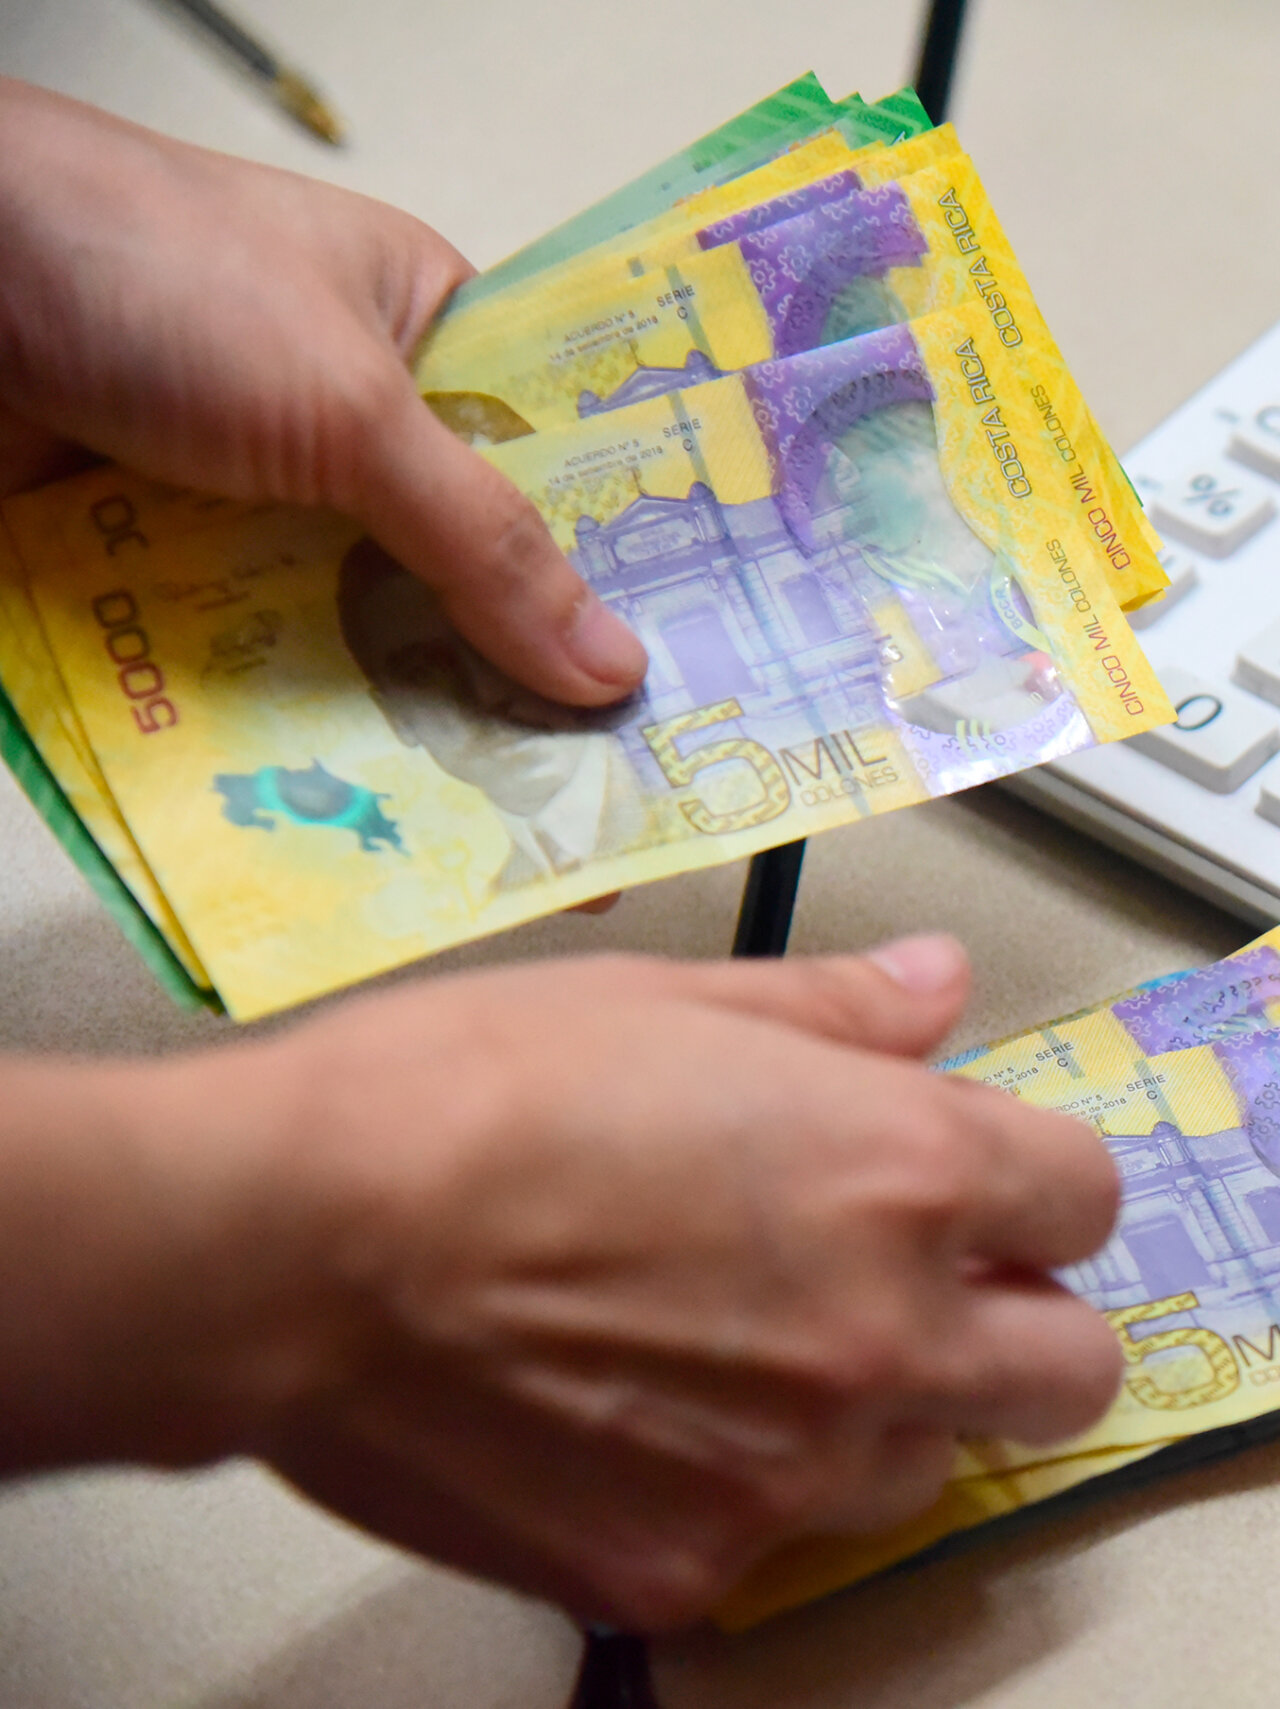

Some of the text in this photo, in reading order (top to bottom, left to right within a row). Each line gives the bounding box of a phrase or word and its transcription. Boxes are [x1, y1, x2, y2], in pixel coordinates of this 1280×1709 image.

[937, 187, 1024, 349] COSTA RICA
[657, 285, 695, 308] SERIE
[677, 306, 688, 320] C
[662, 418, 702, 438] SERIE
[955, 337, 1033, 499] COSTA RICA
[640, 445, 663, 459] 2018
[682, 438, 694, 451] C
[564, 445, 617, 468] ACUERDO
[1030, 384, 1131, 571] CINCO MIL COLONES
[1046, 538, 1144, 716] CINCO MIL COLONES
[92, 587, 181, 735] 5000
[1173, 694, 1223, 732] 0
[640, 696, 888, 835] 5 MIL
[801, 765, 899, 807] COLONES
[1035, 1041, 1074, 1062] SERIE
[1007, 1066, 1015, 1074] 5
[1057, 1057, 1069, 1068] C
[1002, 1078, 1014, 1087] de
[1015, 1067, 1039, 1082] 2018
[1126, 1074, 1167, 1093] SERIE
[1088, 1105, 1101, 1114] de
[1103, 1097, 1127, 1110] 2018
[1095, 1094, 1103, 1102] 5
[1146, 1089, 1158, 1101] C
[1105, 1291, 1241, 1411] 5
